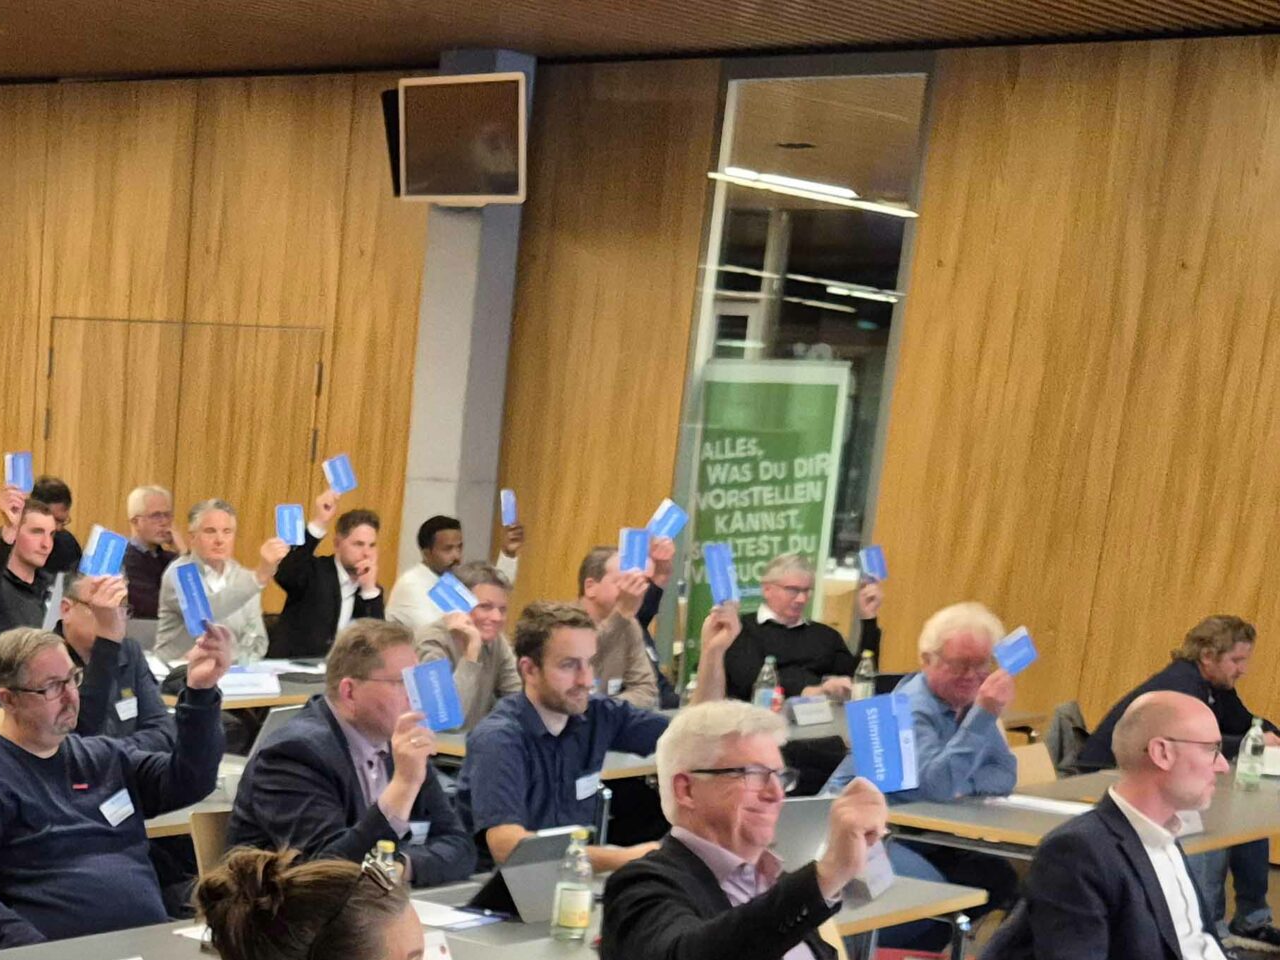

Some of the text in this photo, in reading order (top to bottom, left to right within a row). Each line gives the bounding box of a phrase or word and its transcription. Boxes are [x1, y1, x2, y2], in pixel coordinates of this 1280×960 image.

[701, 438, 763, 461] ALLES,
[706, 453, 832, 486] WAS DU DIR
[698, 480, 824, 510] VORSTELLEN
[788, 534, 817, 553] DU
[865, 707, 886, 782] Stimmkarte
